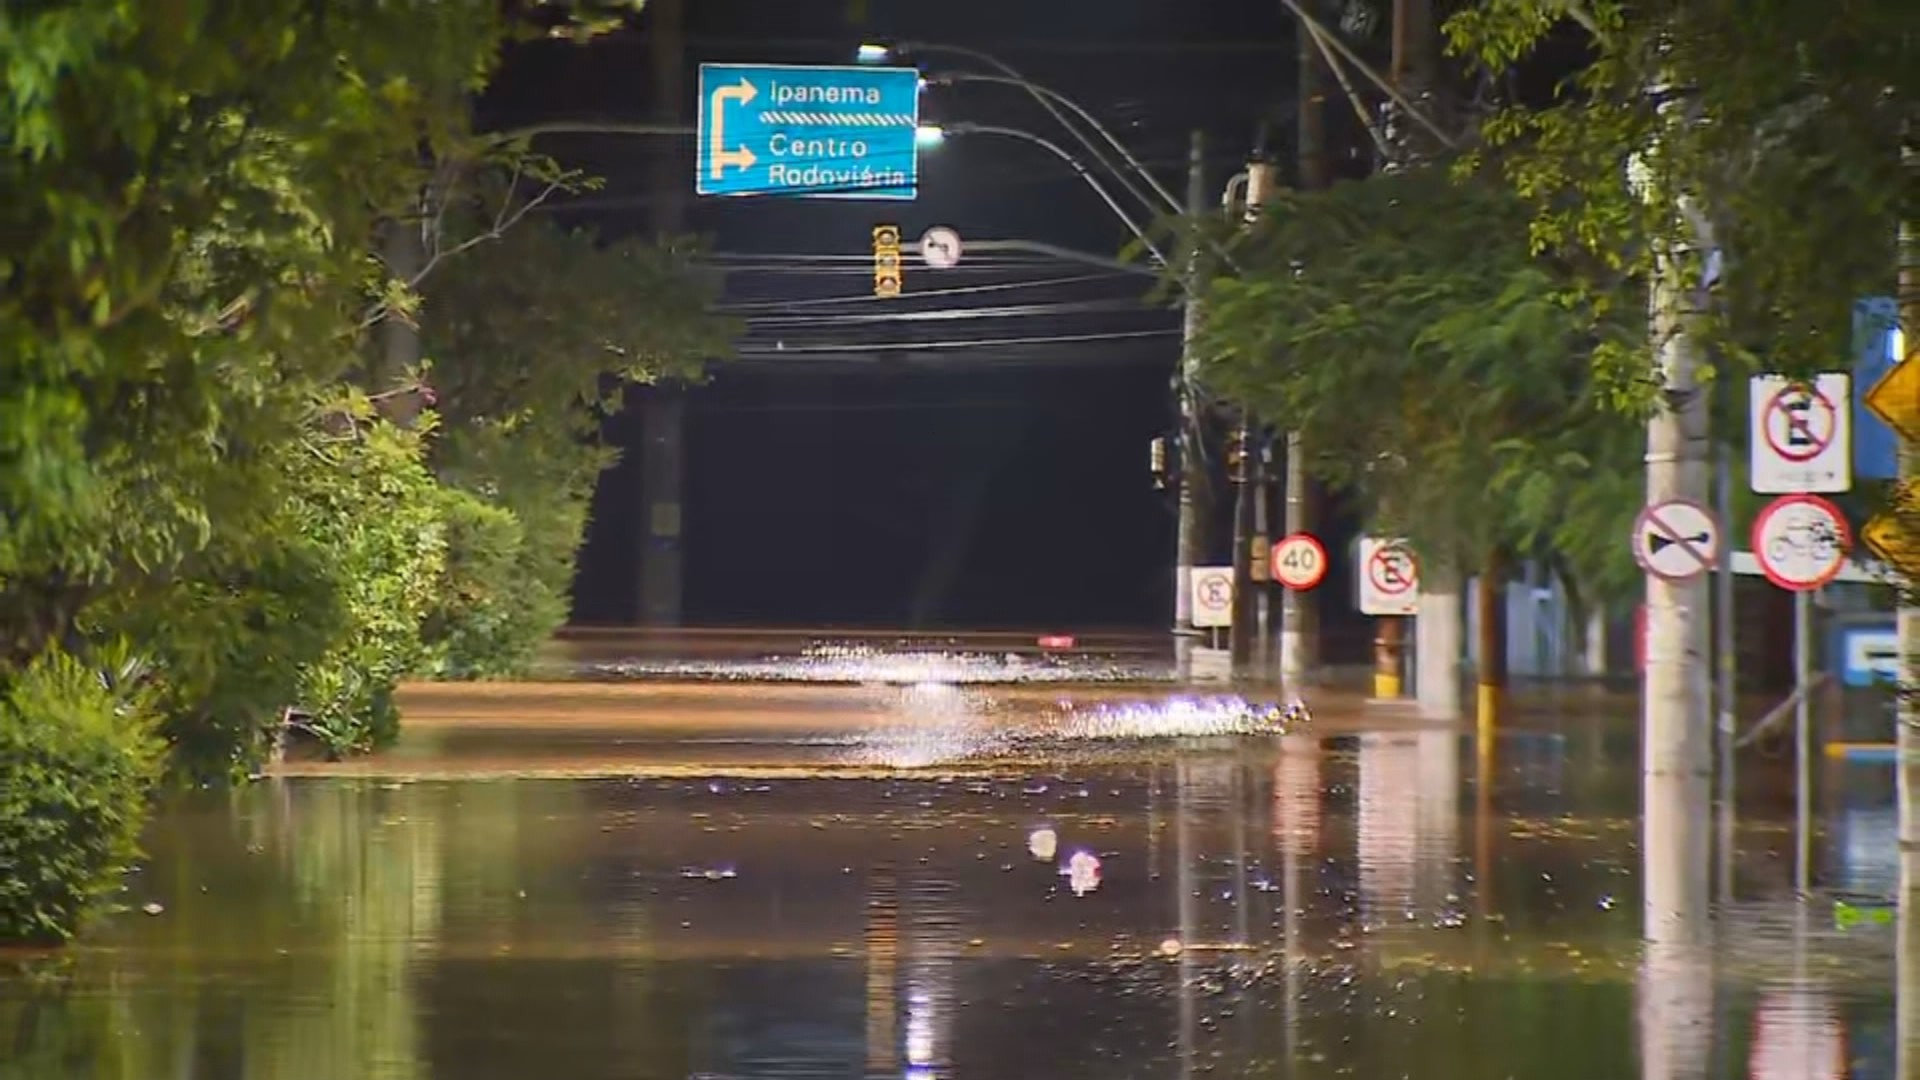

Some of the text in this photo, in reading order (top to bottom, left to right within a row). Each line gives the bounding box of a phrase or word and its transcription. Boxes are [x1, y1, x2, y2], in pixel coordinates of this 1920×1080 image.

[770, 80, 881, 106] Ipanema
[769, 133, 867, 157] Centro
[1282, 548, 1315, 570] 40
